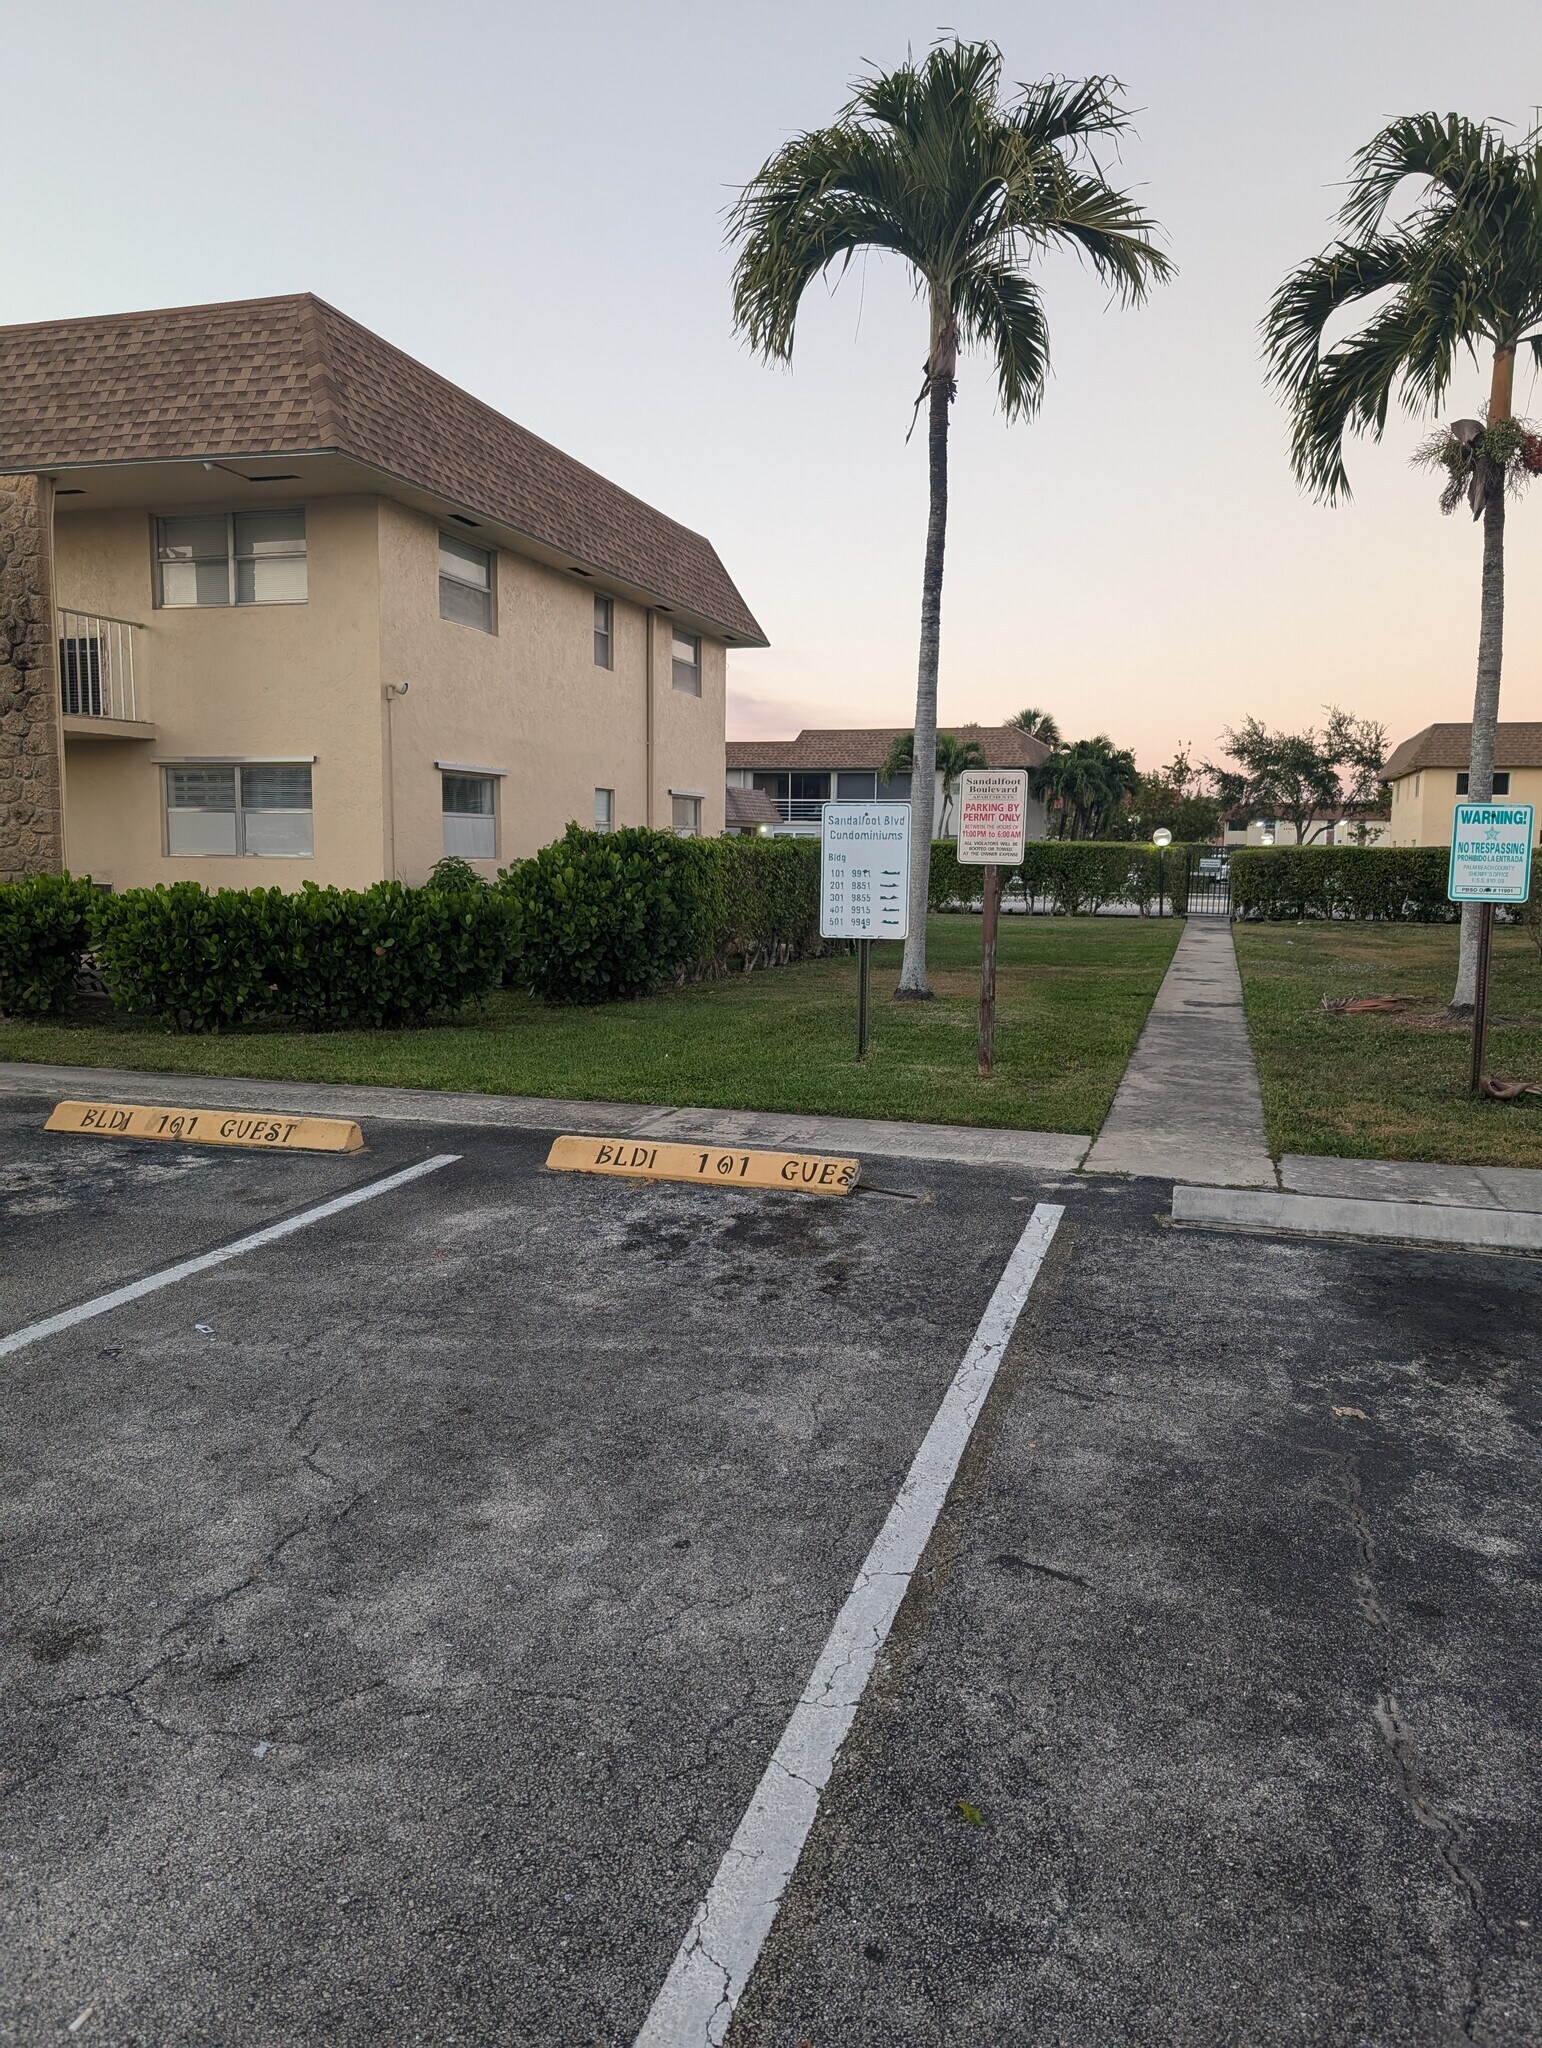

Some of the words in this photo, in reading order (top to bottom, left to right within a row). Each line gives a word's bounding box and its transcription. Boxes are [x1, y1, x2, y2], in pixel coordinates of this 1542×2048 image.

[966, 804, 1004, 812] PARKING
[828, 816, 881, 826] Sandalfoot
[884, 816, 905, 825] Blvd
[999, 814, 1021, 822] ONLY
[1461, 810, 1527, 825] WARNING!
[830, 830, 903, 840] Condominiums
[1458, 842, 1469, 853] NO
[1471, 842, 1525, 854] TRESPASSING
[828, 853, 846, 863] Bldg
[830, 894, 844, 902] 301
[157, 1115, 198, 1136] 101
[220, 1119, 297, 1143] GUEST
[697, 1153, 750, 1176] 101
[781, 1160, 856, 1187] GUES
